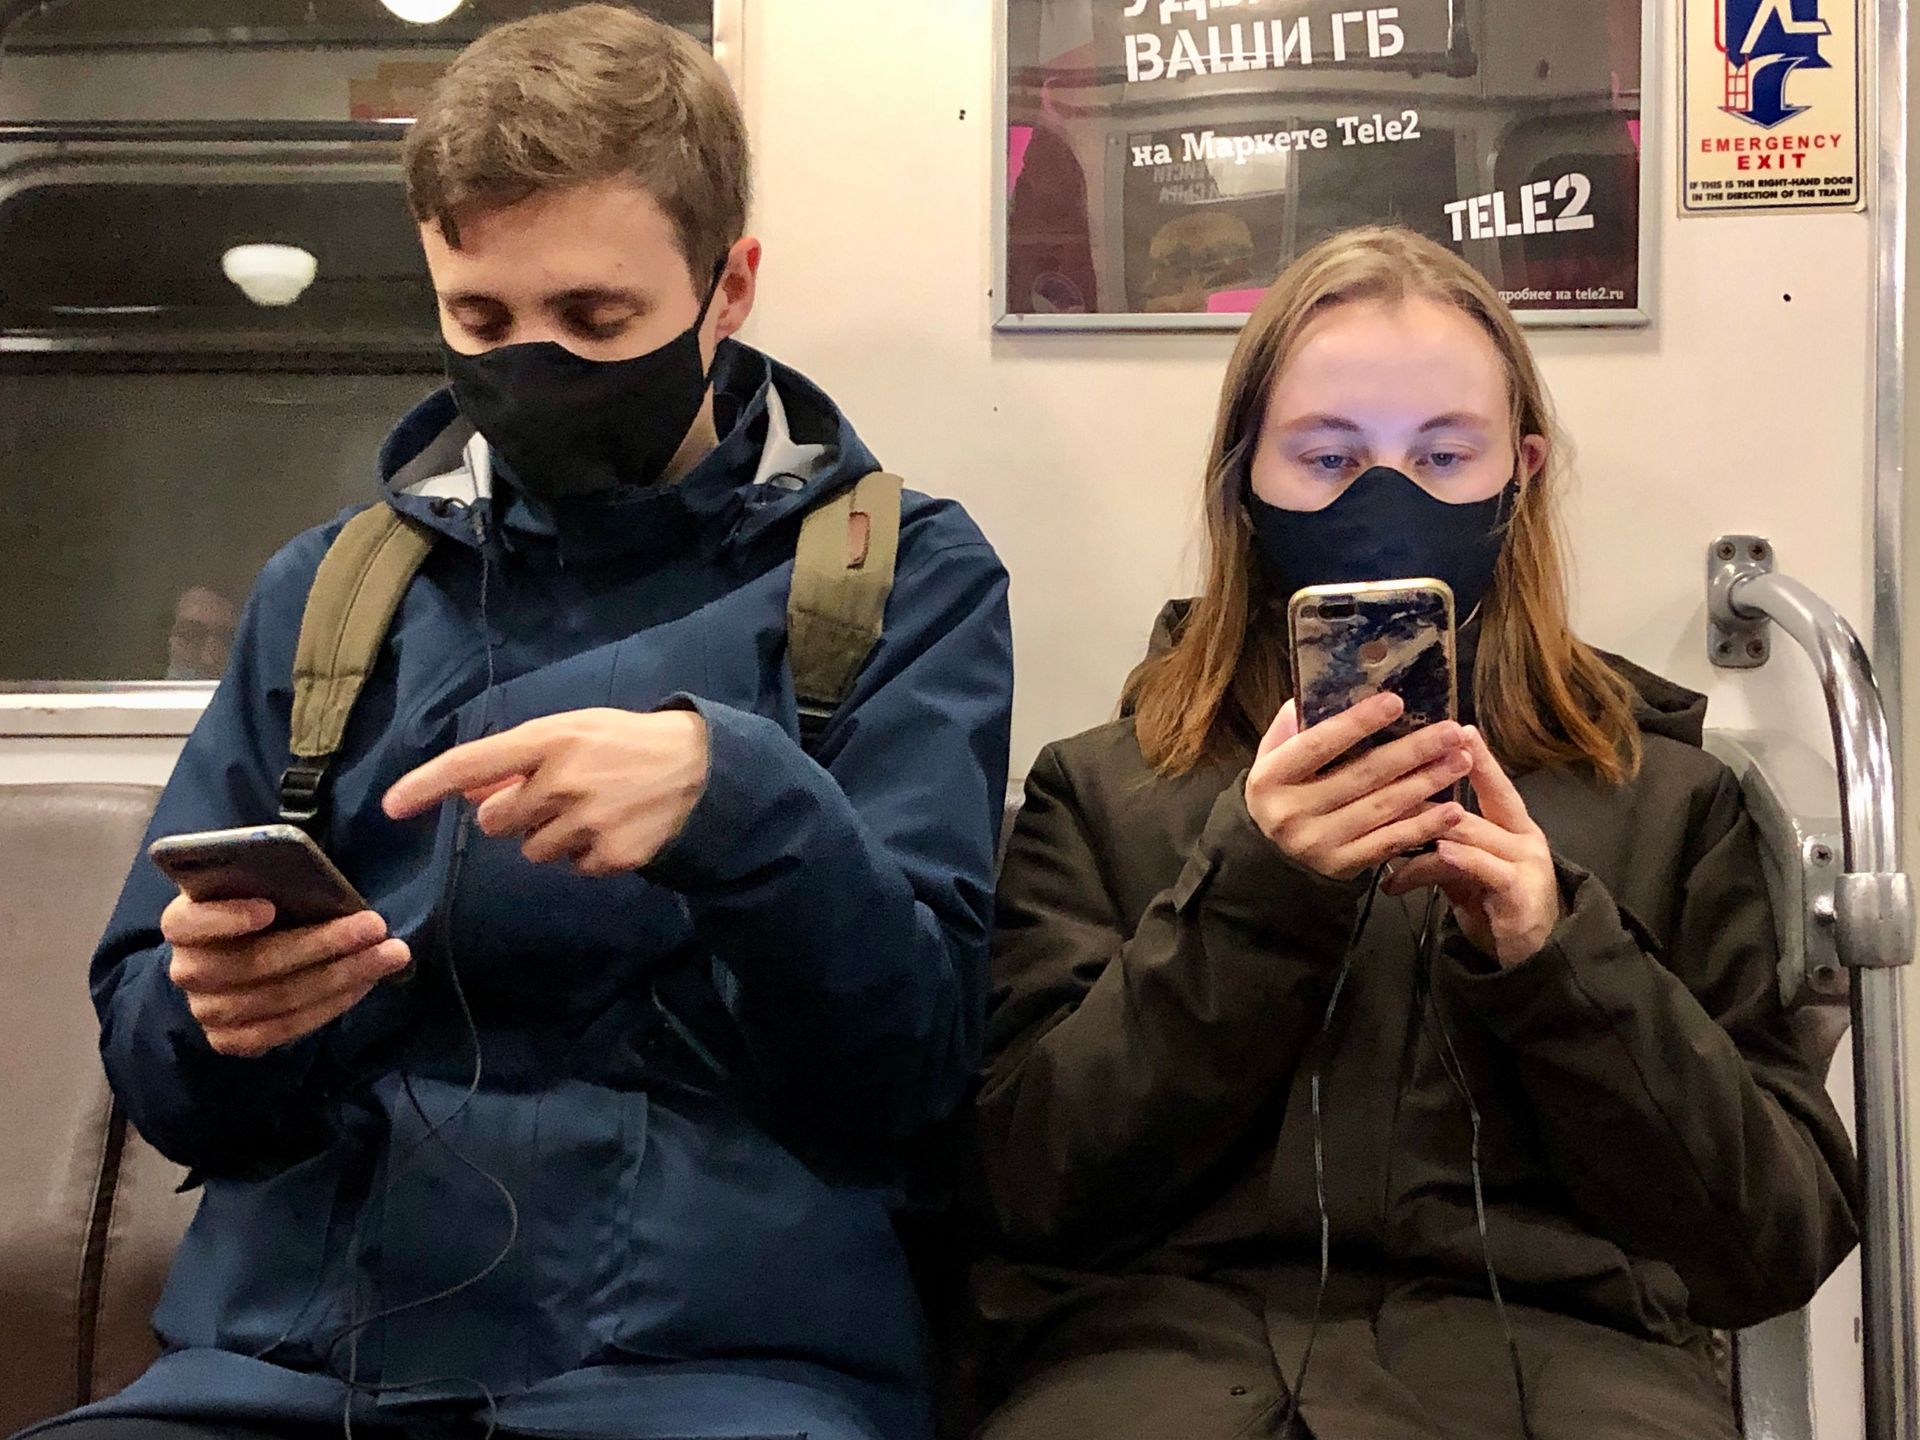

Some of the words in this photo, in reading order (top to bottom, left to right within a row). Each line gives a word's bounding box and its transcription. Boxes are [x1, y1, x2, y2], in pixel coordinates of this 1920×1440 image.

[1125, 16, 1313, 82] ВАШИ
[1332, 7, 1405, 62] ГБ
[1131, 143, 1172, 167] на
[1181, 127, 1328, 165] Маркете
[1336, 110, 1421, 147] Tele2
[1701, 134, 1842, 152] EMERGENCY
[1737, 153, 1806, 171] EXIT
[1689, 181, 1698, 190] IF
[1701, 180, 1722, 189] THIS
[1725, 180, 1734, 188] IS
[1737, 179, 1755, 188] THE
[1758, 177, 1821, 187] RIGHT-HAND
[1823, 176, 1853, 185] DOOR
[1692, 193, 1703, 201] IN
[1706, 192, 1723, 200] THE
[1726, 190, 1778, 200] DIRECTION
[1781, 189, 1794, 198] OF
[1797, 189, 1815, 197] THE
[1444, 172, 1595, 241] TELE2
[1556, 290, 1572, 300] на
[1575, 287, 1624, 300] tele2.ru
